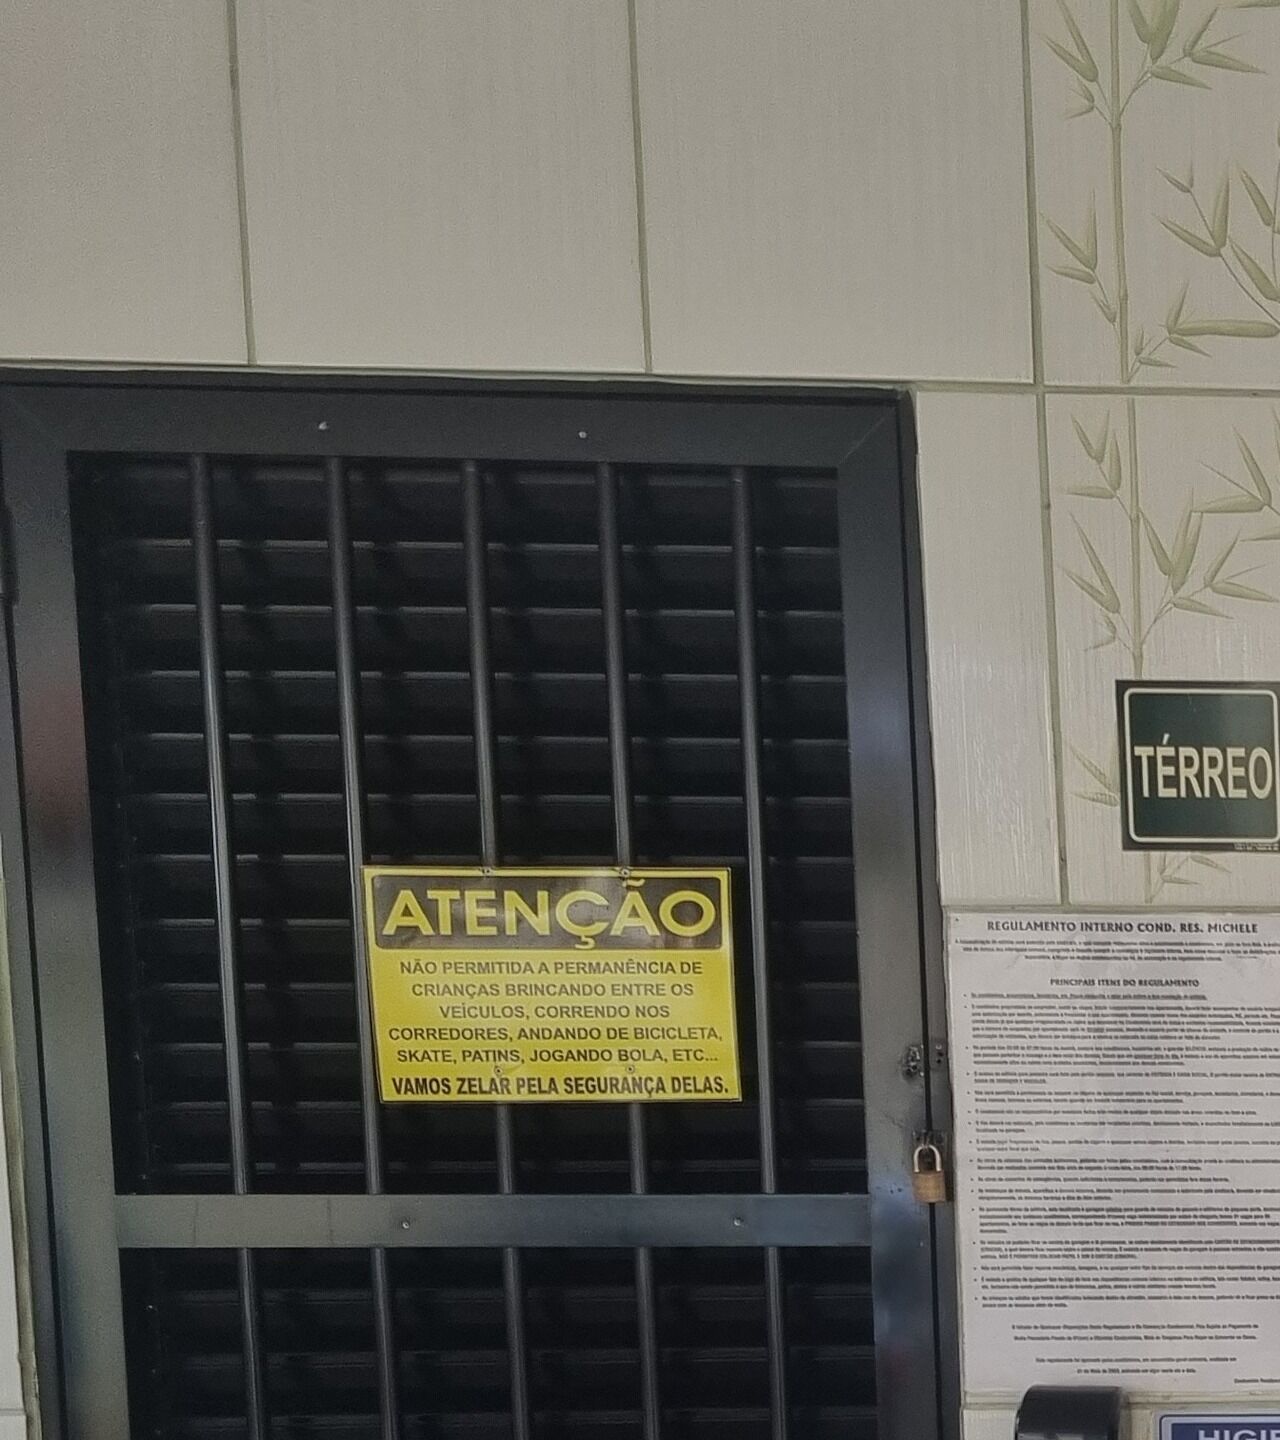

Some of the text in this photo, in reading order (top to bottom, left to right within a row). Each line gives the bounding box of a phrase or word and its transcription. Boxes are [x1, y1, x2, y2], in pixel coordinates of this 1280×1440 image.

[1134, 733, 1272, 799] TÉRREO
[383, 879, 716, 949] ATENÇÃO
[988, 921, 1258, 934] REGULAMENTO INTERNO COND. RES. MICHELE
[400, 958, 702, 975] NÃO PERMITIDA A PERMANÊNCIA DE
[1050, 978, 1199, 988] PRINCIPAIS ITENS DO REGULAMENTO
[412, 984, 694, 999] CRIANÇAS BRINCANDO ENTRE OS
[440, 1003, 669, 1020] VEÍCULOS, CORRENDO NOS
[389, 1027, 723, 1043] CORREDORES, ANDANDO DE BICICLETA,
[397, 1049, 718, 1064] SKATE, PATINS, JOGANDO BOLA, ETC...
[392, 1077, 728, 1097] VAMOS ZELAR PELA SEGURANÇA DELAS.
